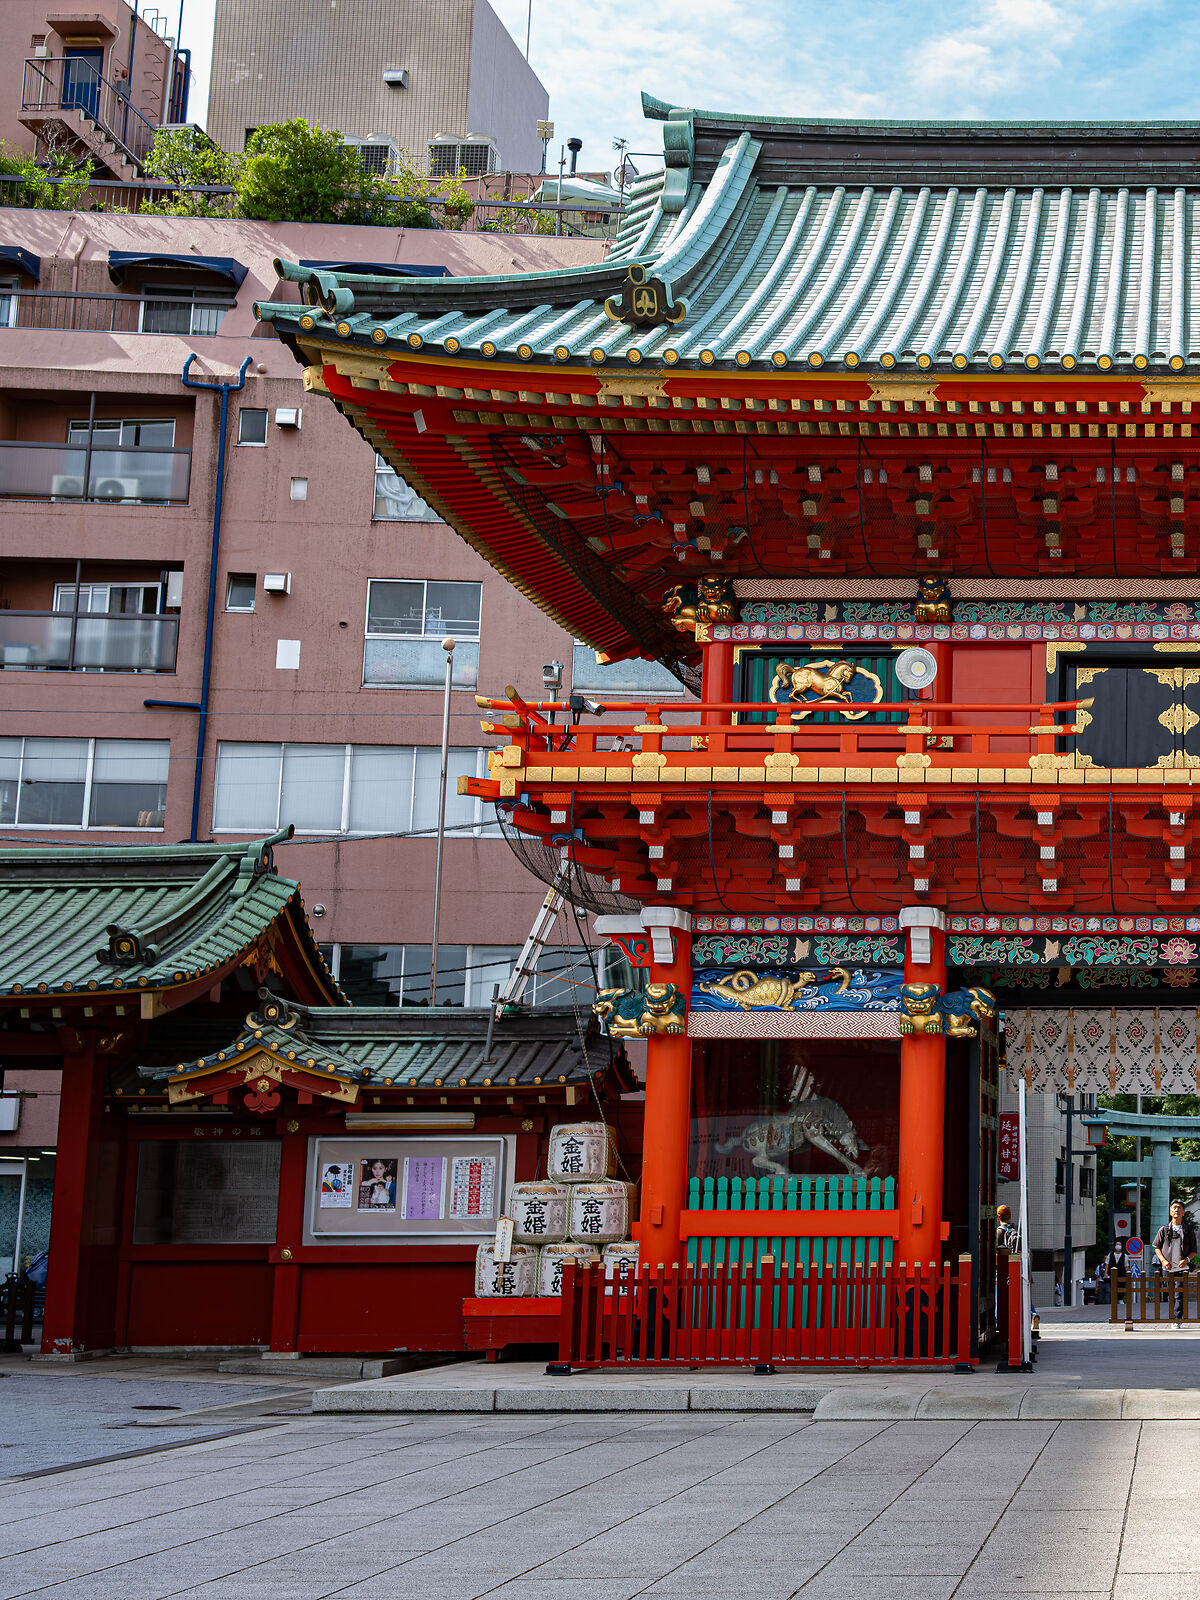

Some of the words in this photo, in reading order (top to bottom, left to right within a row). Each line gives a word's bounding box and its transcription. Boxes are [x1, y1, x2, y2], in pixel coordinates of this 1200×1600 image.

[561, 1136, 585, 1173] 金婚
[1000, 1120, 1012, 1173] 延寿甘酒
[523, 1197, 548, 1234] 金婚
[580, 1197, 604, 1234] 金婚
